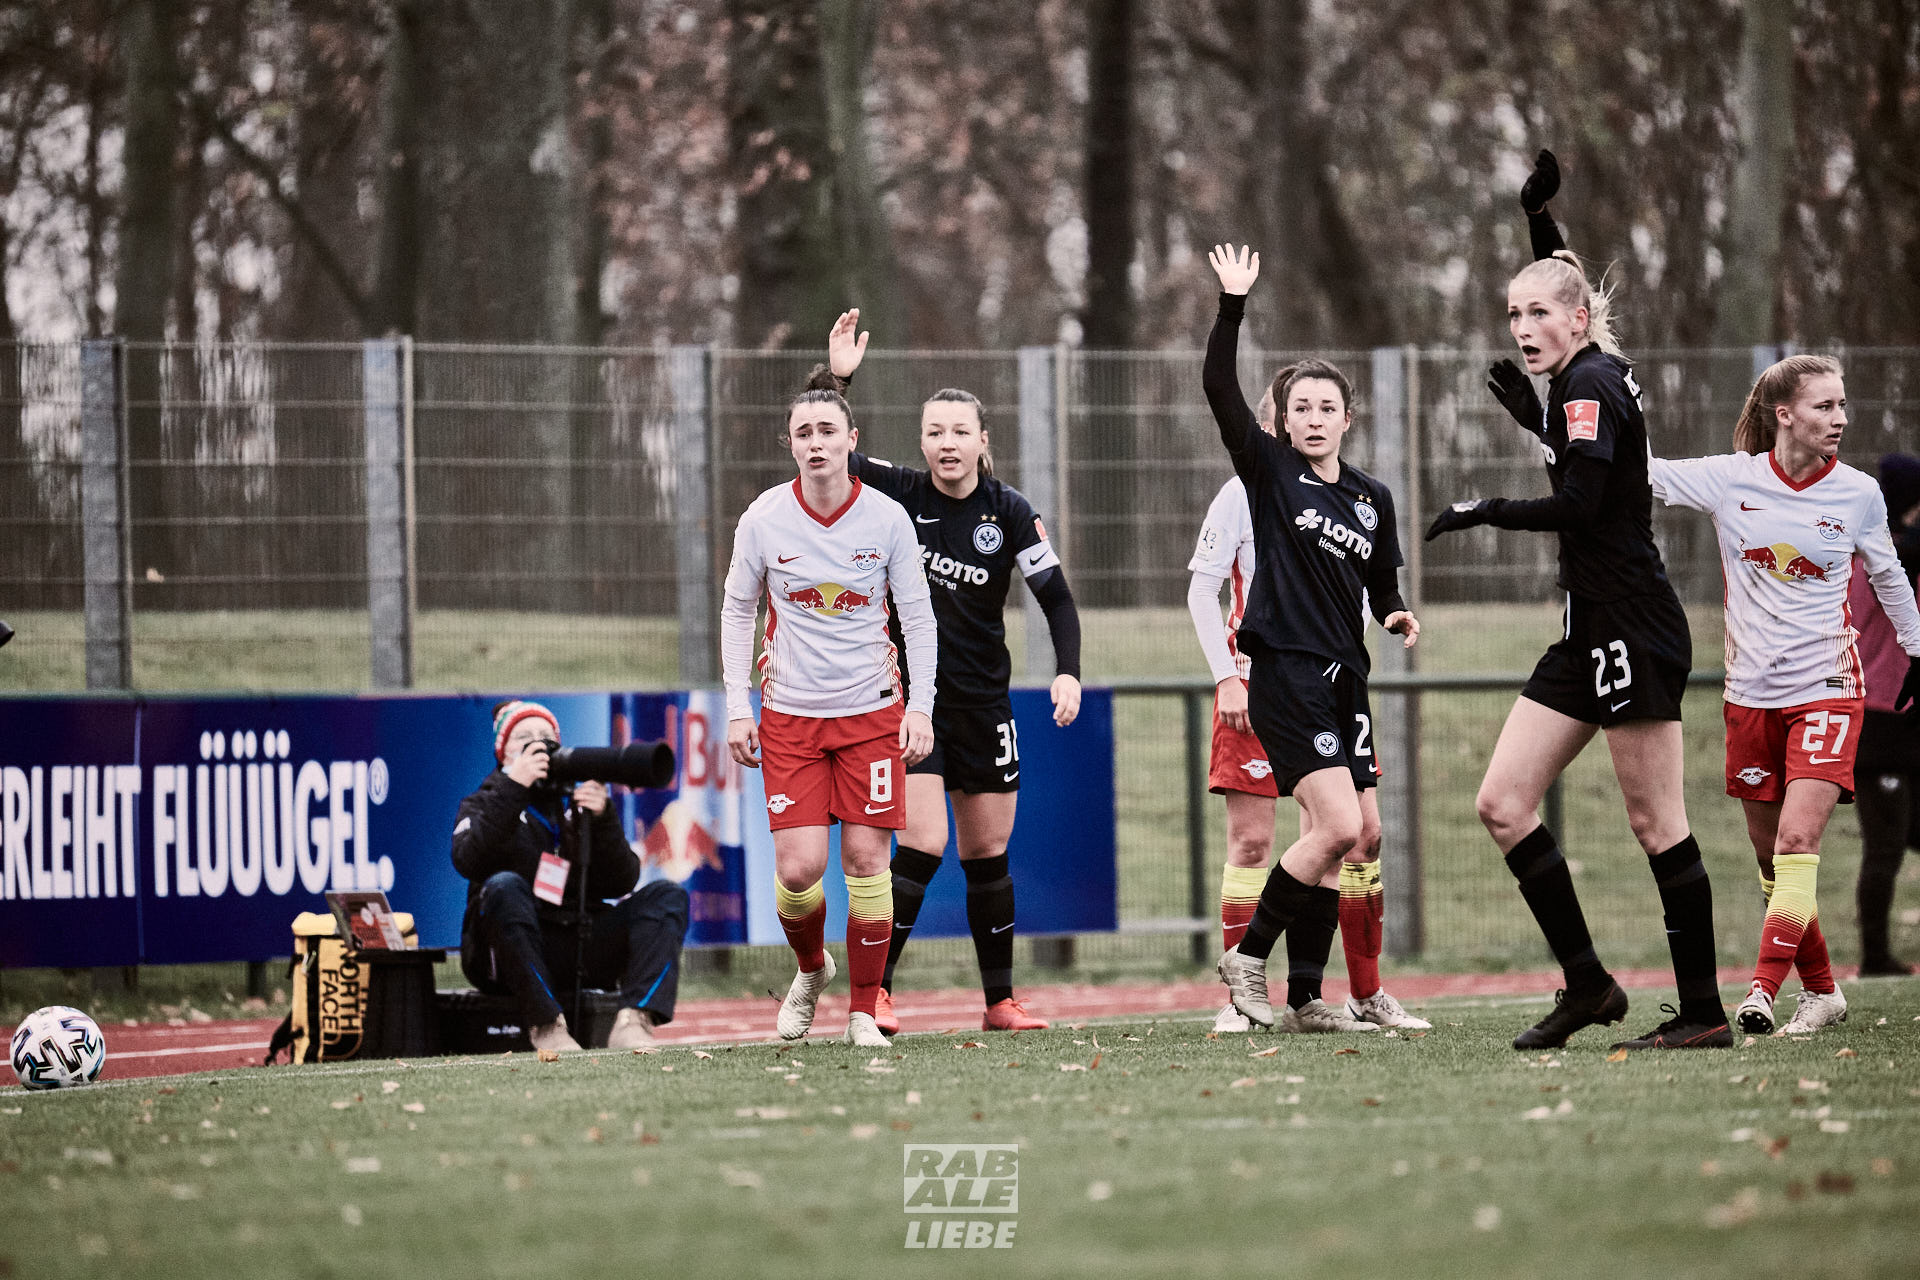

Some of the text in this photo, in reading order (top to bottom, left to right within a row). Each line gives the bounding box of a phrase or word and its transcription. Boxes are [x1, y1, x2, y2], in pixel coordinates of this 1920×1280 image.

[1318, 536, 1346, 560] Hessen
[1322, 516, 1373, 560] LOTTO
[930, 552, 989, 586] LOTTO
[1591, 638, 1632, 698] 23
[1801, 710, 1850, 756] 27
[869, 757, 893, 803] 8
[0, 764, 141, 901] RLEIHT
[321, 968, 338, 1030] FACE
